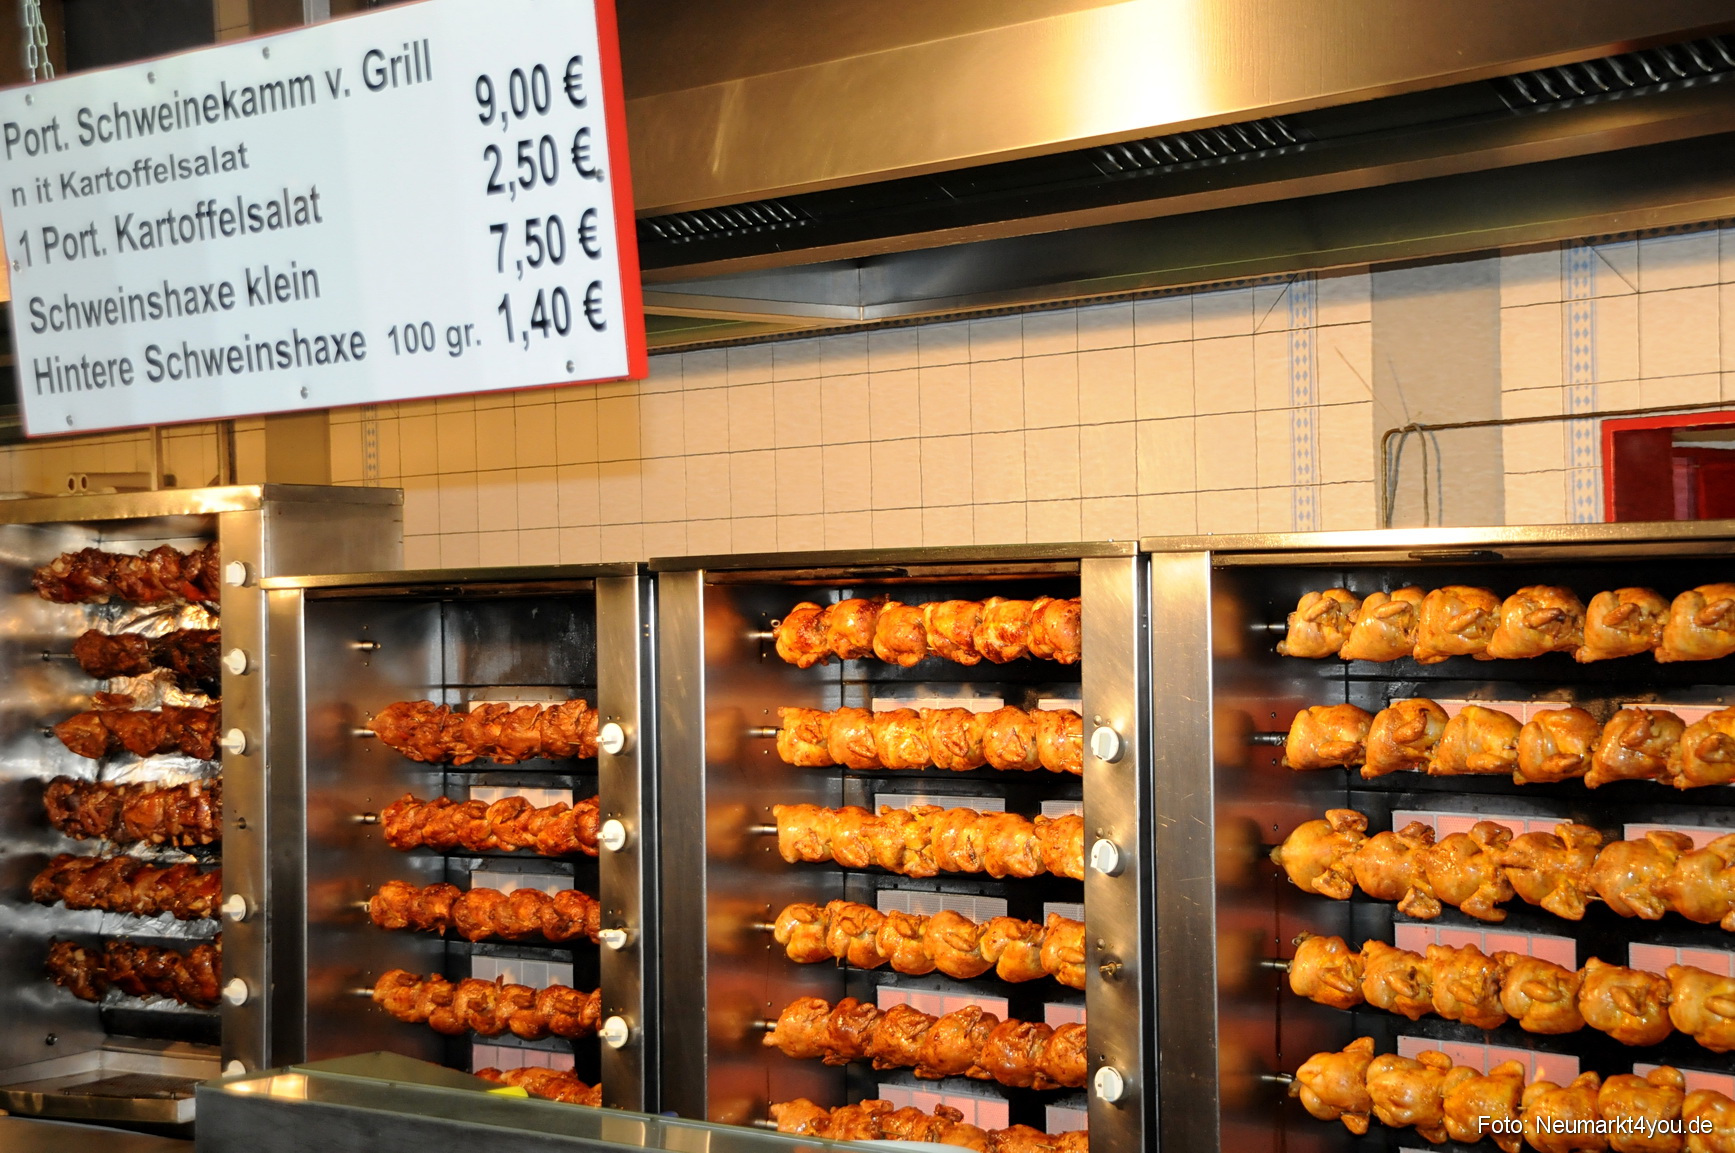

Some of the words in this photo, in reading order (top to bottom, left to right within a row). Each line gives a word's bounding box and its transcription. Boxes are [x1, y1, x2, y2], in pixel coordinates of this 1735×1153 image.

[3, 115, 70, 161] Port.
[77, 74, 316, 148] Schweinekamm
[325, 68, 351, 99] v.
[362, 38, 432, 92] Grill
[60, 142, 250, 200] Kartoffelsalat
[475, 63, 550, 132] 9,00
[563, 54, 588, 109] €
[19, 229, 32, 268] 1
[42, 220, 108, 264] Port.
[114, 186, 324, 254] Kartoffelsalat
[483, 134, 558, 203] 2,50
[571, 127, 597, 181] €
[28, 279, 237, 335] Schweinshaxe
[245, 263, 320, 308] klein
[489, 214, 565, 282] 7,50
[577, 207, 602, 260] €
[33, 355, 135, 396] Hintere
[144, 329, 367, 384] Schweinshaxe
[387, 321, 436, 357] 100
[446, 324, 482, 358] gr.
[497, 286, 571, 351] 1,40
[583, 280, 607, 333] €
